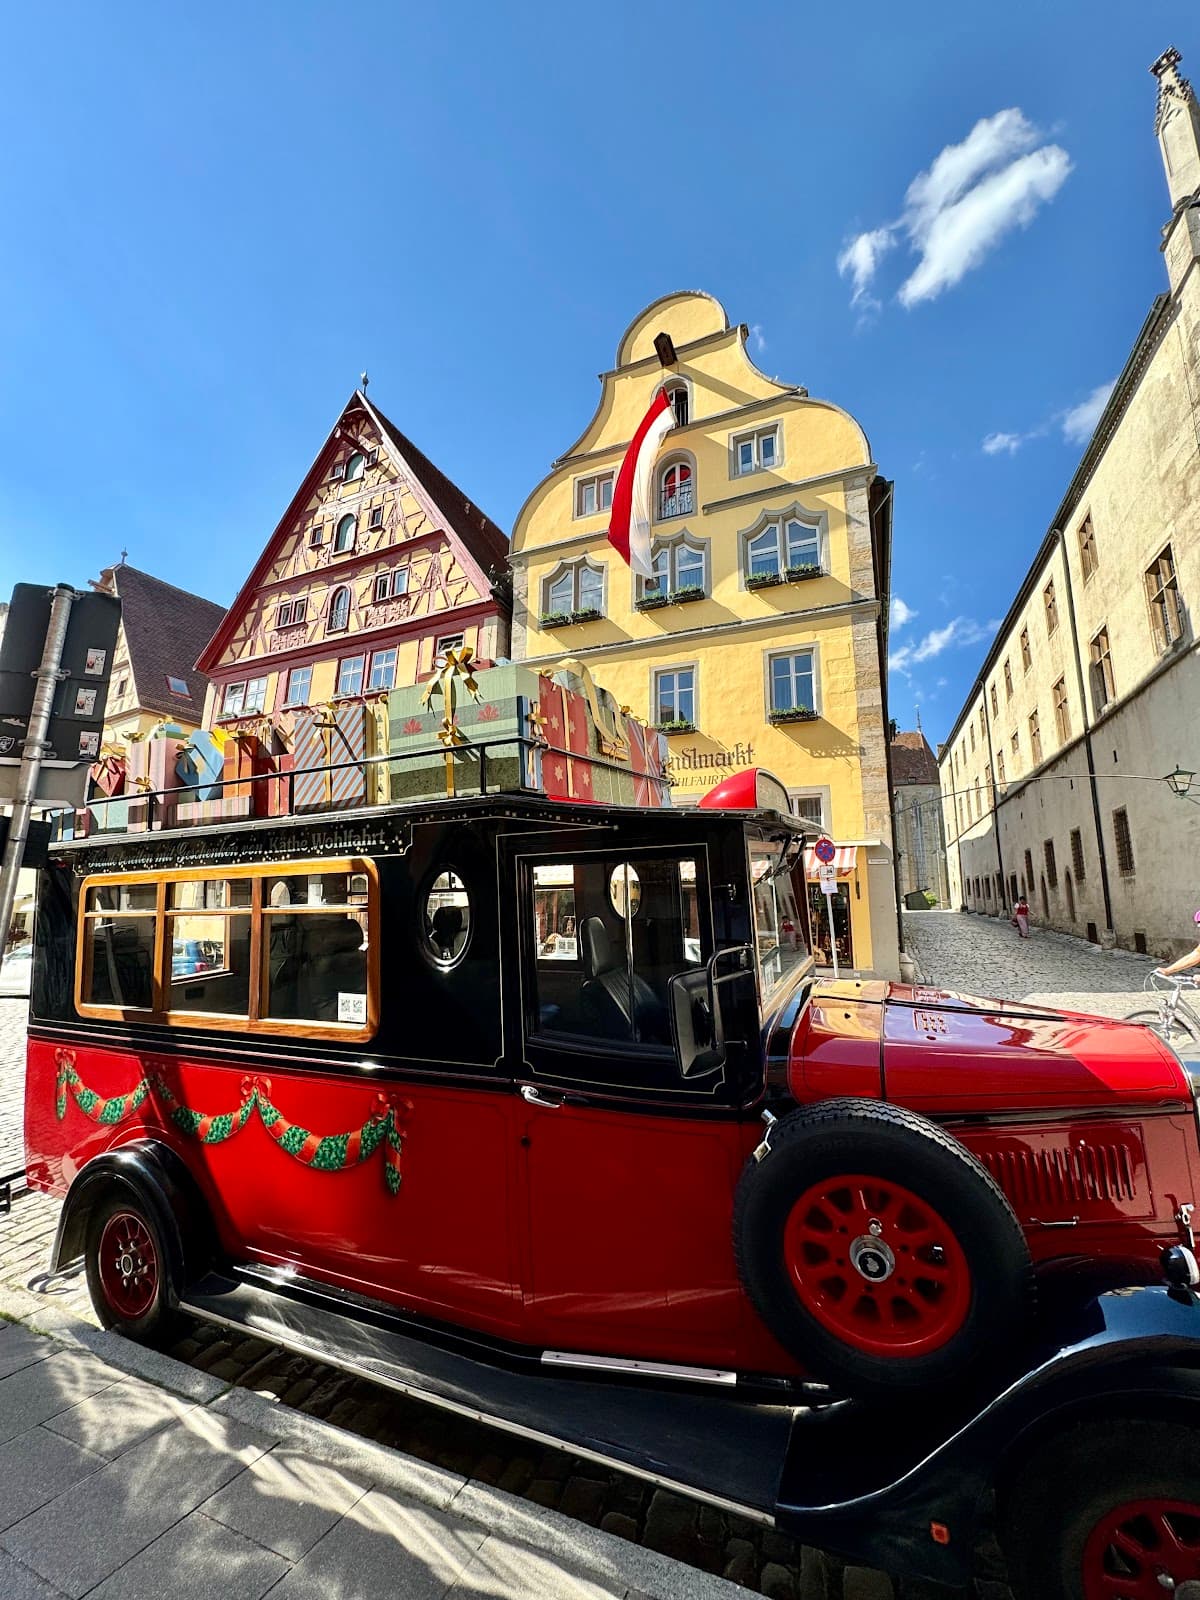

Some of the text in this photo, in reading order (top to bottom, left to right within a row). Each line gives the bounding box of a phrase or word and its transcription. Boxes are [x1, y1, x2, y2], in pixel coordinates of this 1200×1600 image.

[671, 742, 755, 770] ndlmarkt
[678, 774, 727, 786] HLFAHRT
[240, 843, 262, 855] von
[268, 832, 308, 853] Käthe
[311, 828, 386, 850] Wohlfahrt
